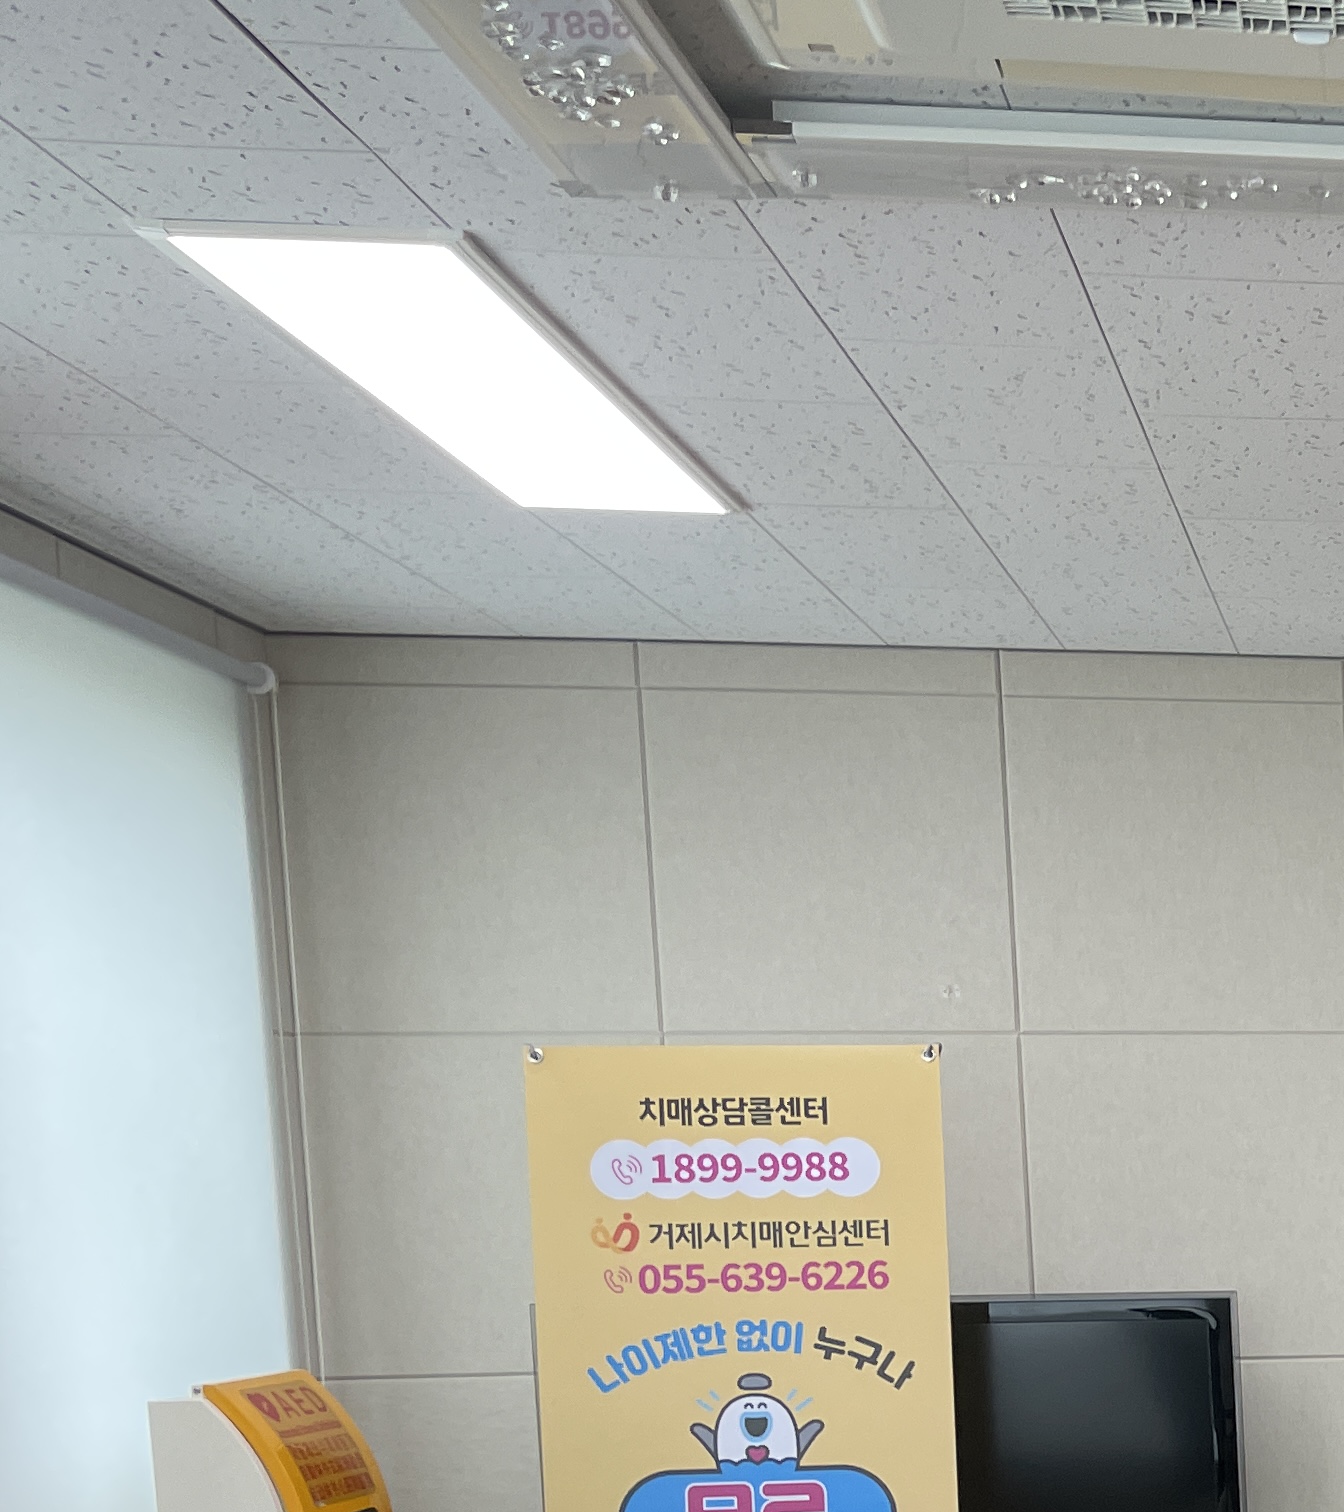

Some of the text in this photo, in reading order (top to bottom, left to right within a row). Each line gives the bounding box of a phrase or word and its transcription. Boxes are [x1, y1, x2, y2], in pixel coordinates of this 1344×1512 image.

[639, 1097, 829, 1126] 치매상담콜센터
[651, 1151, 850, 1184] 1899-9988
[649, 1219, 890, 1250] 거제시치매안심센터
[638, 1260, 890, 1294] 055-639-6226
[587, 1320, 916, 1393] 나이제한 없이 누구나
[271, 1387, 328, 1418] AED
